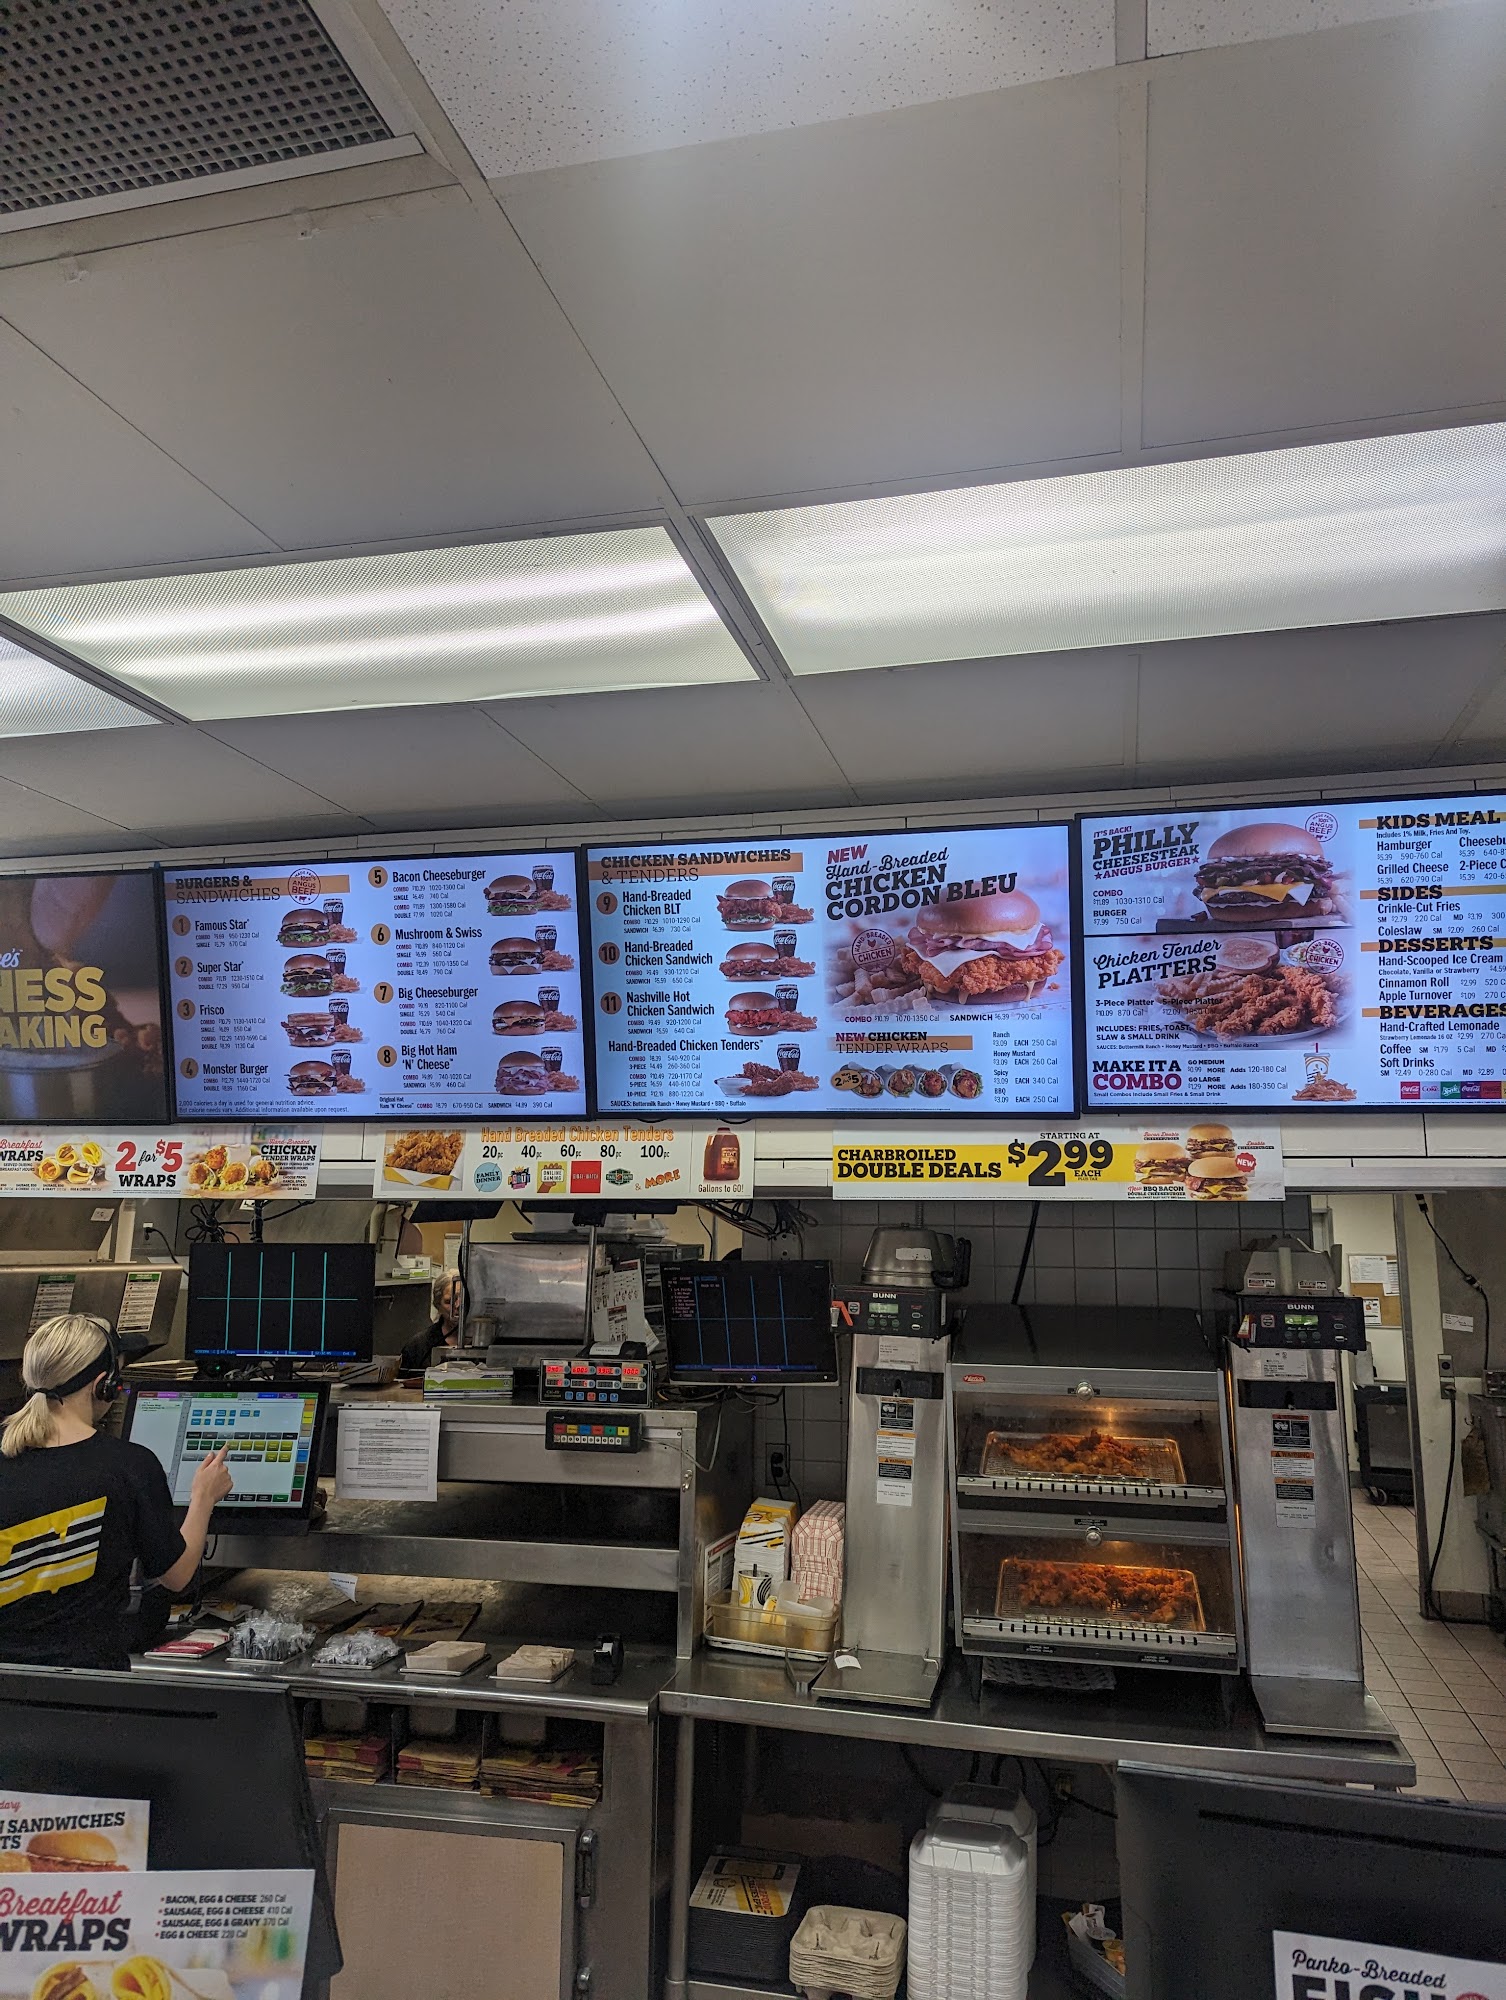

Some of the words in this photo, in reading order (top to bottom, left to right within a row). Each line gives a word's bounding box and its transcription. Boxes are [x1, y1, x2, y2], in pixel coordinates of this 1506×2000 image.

[1377, 814, 1430, 830] KIDS
[1435, 810, 1500, 827] MEAL
[1094, 830, 1107, 838] IT'S
[1109, 826, 1132, 836] BACK!
[1093, 822, 1199, 860] PHILLY
[1377, 840, 1432, 851] Hamburger
[601, 854, 674, 868] CHICKEN
[678, 849, 791, 865] SANDWICHES
[828, 844, 868, 864] NEW
[1093, 844, 1199, 871] CHEESESTEAK
[826, 847, 949, 879] Hand-Breaded
[1103, 865, 1143, 879] ANGUS
[1145, 858, 1192, 872] BURGER
[1378, 864, 1409, 874] Grilled
[1413, 862, 1448, 872] Cheese
[374, 870, 381, 884] 5
[393, 872, 420, 882] Bacon
[423, 869, 486, 881] Cheeseburger
[602, 871, 613, 884] &
[617, 868, 699, 883] TENDERS
[825, 863, 947, 900] CHICKEN
[176, 876, 239, 889] BURGERS
[243, 876, 252, 886] &
[177, 888, 280, 904] SANDWICHES
[623, 889, 691, 902] Hand-Breaded
[827, 884, 941, 920] CORDON
[946, 873, 1017, 902] BLEU
[1378, 885, 1442, 901] SIDES
[603, 896, 610, 911] 9
[624, 904, 661, 916] Chicken
[664, 903, 681, 914] BLT
[1378, 902, 1433, 914] Crinkle-Cut
[1436, 902, 1460, 911] Fries
[179, 919, 184, 932] 1
[195, 920, 227, 931] Famous
[1378, 926, 1422, 936] Coleslaw
[378, 928, 384, 941] 6
[396, 929, 443, 940] Mushroom
[446, 928, 453, 938] &
[456, 927, 482, 938] Swiss
[625, 940, 693, 953] Hand-Breaded
[1379, 936, 1493, 953] DESSERTS
[602, 947, 616, 961] 10
[626, 955, 663, 967] Chicken
[666, 952, 713, 965] Sandwich
[1094, 950, 1159, 971] Chicken
[1162, 939, 1222, 959] Tender
[181, 961, 187, 974] 2
[198, 962, 221, 974] Super
[1098, 955, 1217, 989] PLATTERS
[380, 986, 387, 1000] 7
[399, 988, 413, 1000] Big
[416, 987, 478, 999] Cheeseburger
[627, 992, 670, 1002] Nashville
[673, 991, 690, 1002] Hot
[1379, 991, 1406, 1003] Apple
[1409, 990, 1452, 1000] Turnover
[183, 1003, 190, 1016] 3
[606, 995, 617, 1011] 11
[200, 1005, 224, 1015] Frisco
[628, 1006, 665, 1016] Chicken
[668, 1004, 714, 1015] Sandwich
[1380, 1004, 1506, 1019] BEVERAGES
[1164, 1024, 1192, 1032] TOAST,
[1380, 1022, 1445, 1032] Hand-Crafted
[1448, 1021, 1499, 1031] Lemonade
[836, 1032, 865, 1042] NEW
[868, 1032, 927, 1041] CHICKEN
[402, 1045, 416, 1057] Big
[418, 1045, 434, 1055] Hot
[437, 1045, 457, 1055] Ham
[609, 1040, 676, 1052] Hand-Breaded
[680, 1040, 718, 1051] Chicken
[836, 1043, 894, 1054] TENDER
[896, 1042, 948, 1053] WRAPS
[1380, 1044, 1411, 1054] Coffee
[384, 1050, 390, 1063] 8
[1381, 1058, 1400, 1067] Soft
[1403, 1058, 1434, 1067] Drinks
[186, 1062, 192, 1075] 4
[203, 1064, 237, 1074] Monster
[240, 1064, 268, 1076] Burger
[417, 1059, 450, 1070] Cheese
[1093, 1061, 1146, 1072] MAKE
[1148, 1060, 1164, 1072] IT
[1165, 1060, 1181, 1072] A
[1093, 1074, 1182, 1090] COMBO
[481, 1127, 511, 1143] Hand
[515, 1126, 565, 1142] Breaded
[569, 1126, 619, 1142] Chicken
[623, 1125, 674, 1142] Tenders
[0, 1139, 43, 1151] Breakfast
[261, 1145, 317, 1155] CHICKEN
[115, 1141, 136, 1172] 2
[138, 1151, 157, 1167] for
[156, 1139, 183, 1172] $5
[838, 1149, 956, 1161] CHARBROILED
[1237, 1158, 1254, 1167] NEW
[838, 1163, 923, 1178] DOUBLE
[929, 1162, 1001, 1178] DEALS
[119, 1175, 176, 1187] WRAPS
[645, 1169, 680, 1189] MORE
[698, 1184, 722, 1192] Gallons
[8, 1812, 125, 1834] SANDWICHES
[0, 1887, 122, 1921] Breakfast
[166, 1895, 195, 1904] BACON,
[199, 1895, 216, 1903] EGG
[218, 1895, 223, 1903] &
[225, 1894, 257, 1903] CHEESE
[275, 1894, 286, 1902] Cal
[1292, 1950, 1446, 1989] Panko-Breaded
